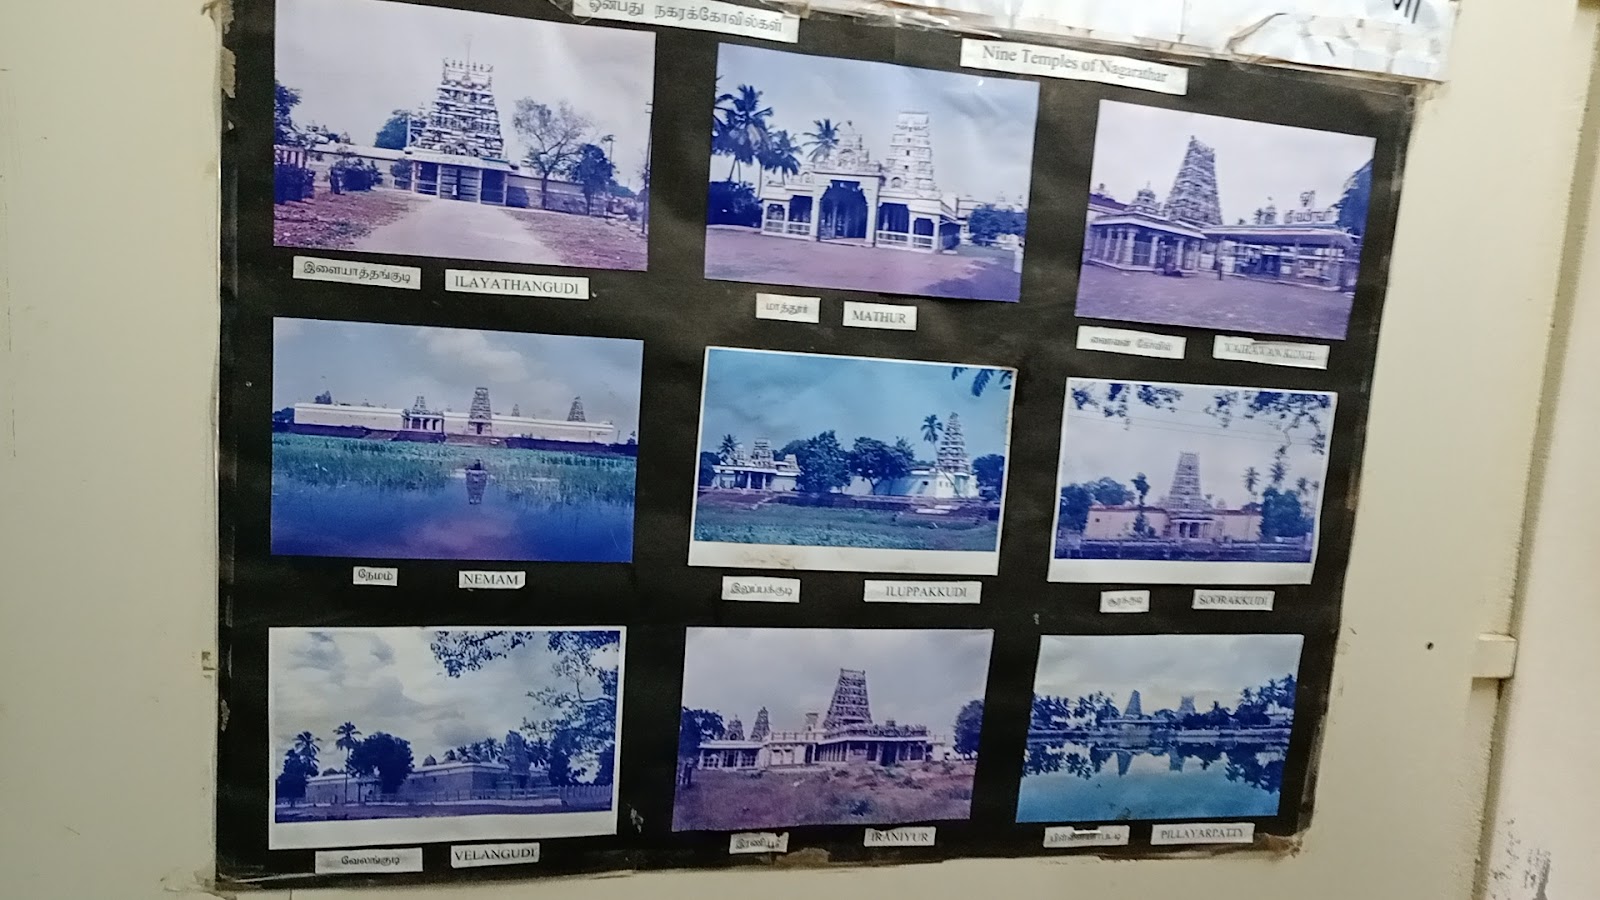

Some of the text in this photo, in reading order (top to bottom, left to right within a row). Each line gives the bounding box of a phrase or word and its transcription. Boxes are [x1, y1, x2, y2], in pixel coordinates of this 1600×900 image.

[982, 44, 1169, 83] Nine Temples of Nagarathar
[455, 275, 579, 295] ILAYATHANGUDI
[852, 310, 906, 324] MATHUR
[358, 568, 393, 581] நேமம்
[463, 573, 519, 585] NEMAM
[886, 585, 967, 598] ILUPPAKKUDI
[1198, 594, 1268, 606] SOORAKKUDI
[871, 831, 929, 842] IRANIYUR
[1161, 828, 1245, 839] PILLAYARPATTY
[454, 848, 536, 861] VELANGUDI
